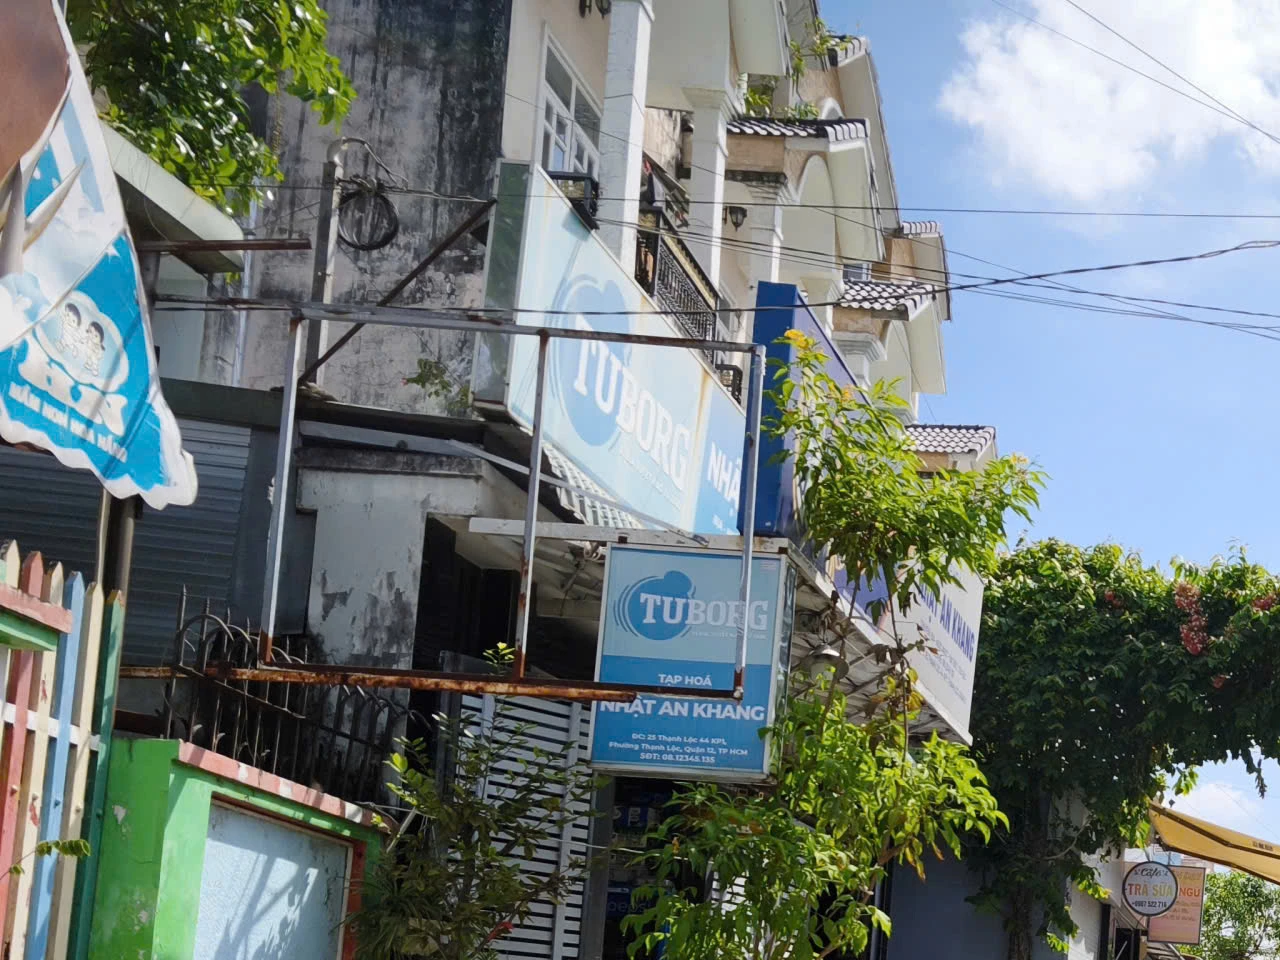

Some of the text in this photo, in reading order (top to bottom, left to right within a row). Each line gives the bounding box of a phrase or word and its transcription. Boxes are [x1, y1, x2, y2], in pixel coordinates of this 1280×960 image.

[574, 313, 691, 492] TUBORG
[658, 700, 689, 717] AN
[692, 703, 765, 721] KHANG
